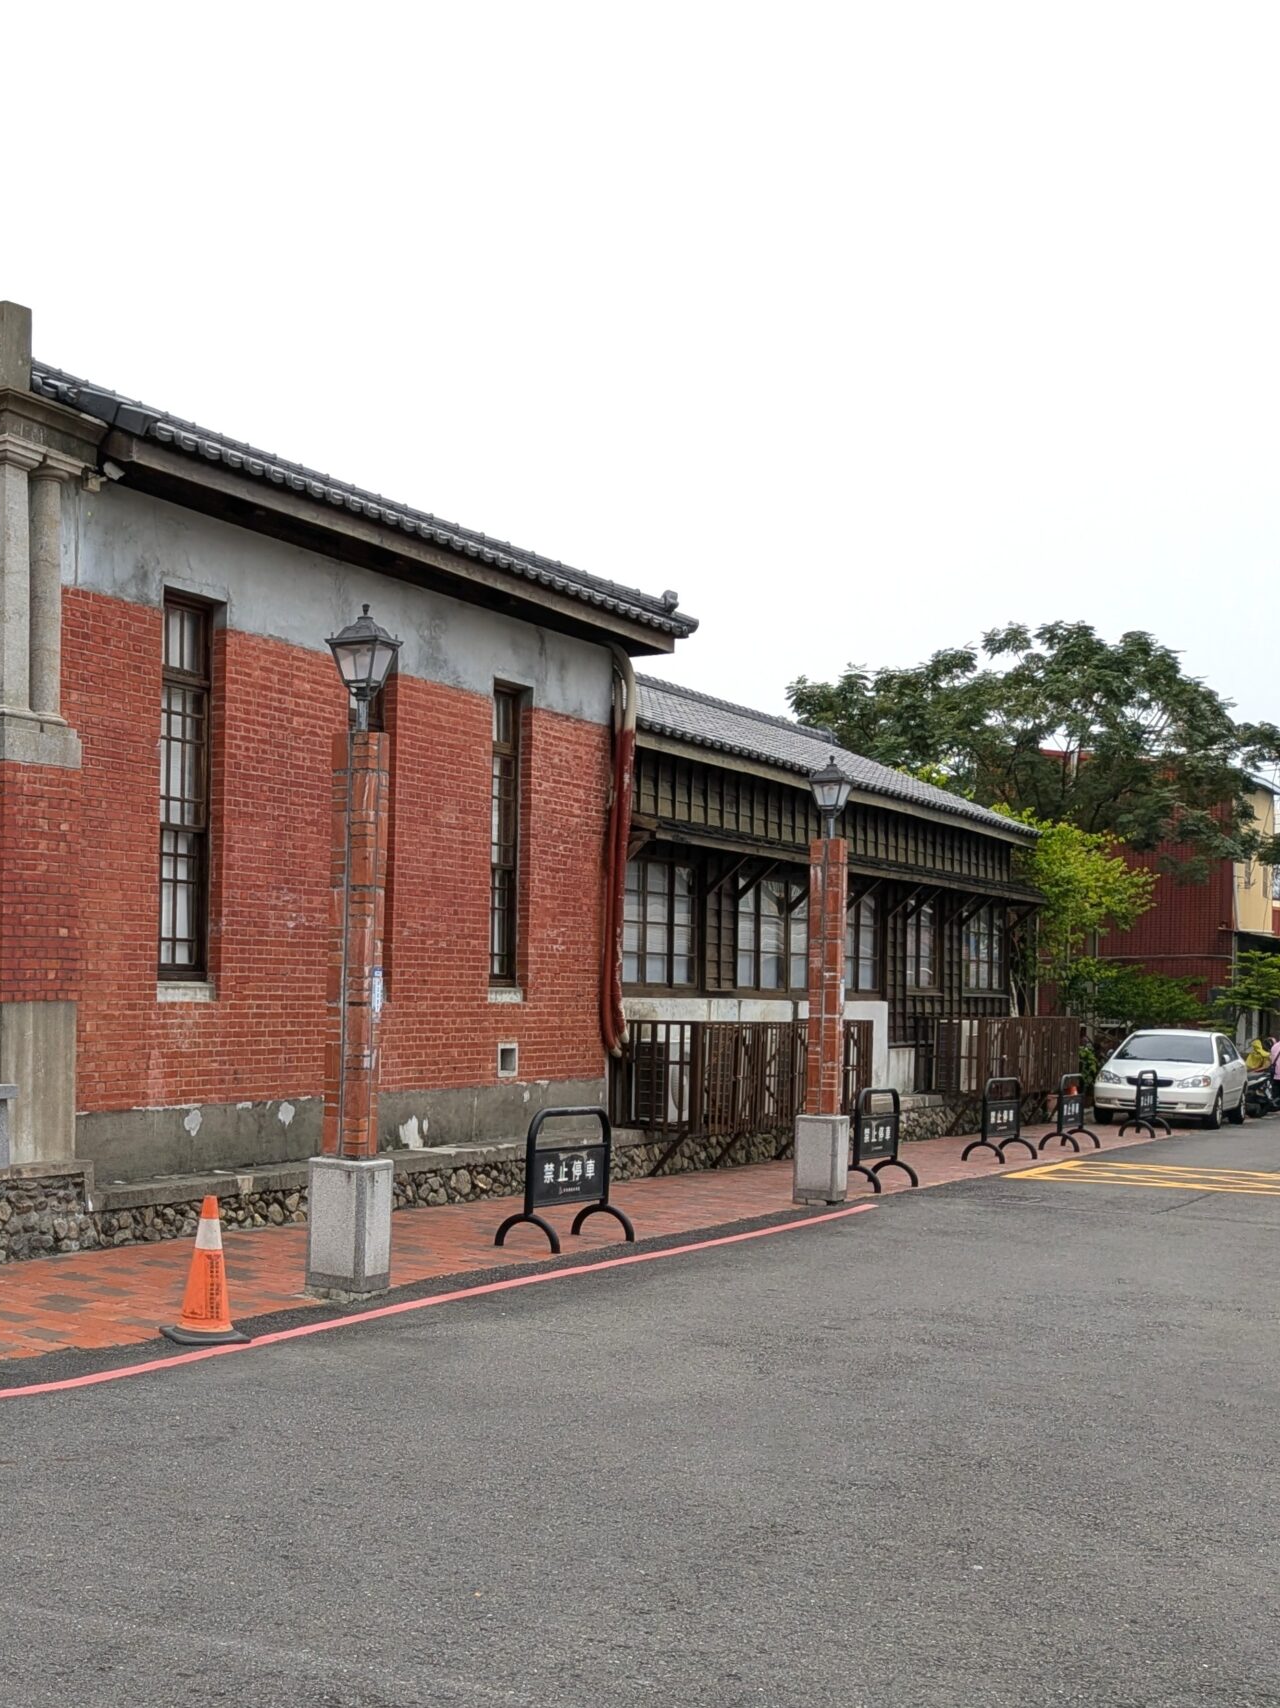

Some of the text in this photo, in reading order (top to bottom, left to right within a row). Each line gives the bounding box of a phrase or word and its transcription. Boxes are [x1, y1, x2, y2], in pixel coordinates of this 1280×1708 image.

[864, 1126, 891, 1143] 禁止停車
[543, 1159, 596, 1184] 禁止停車
